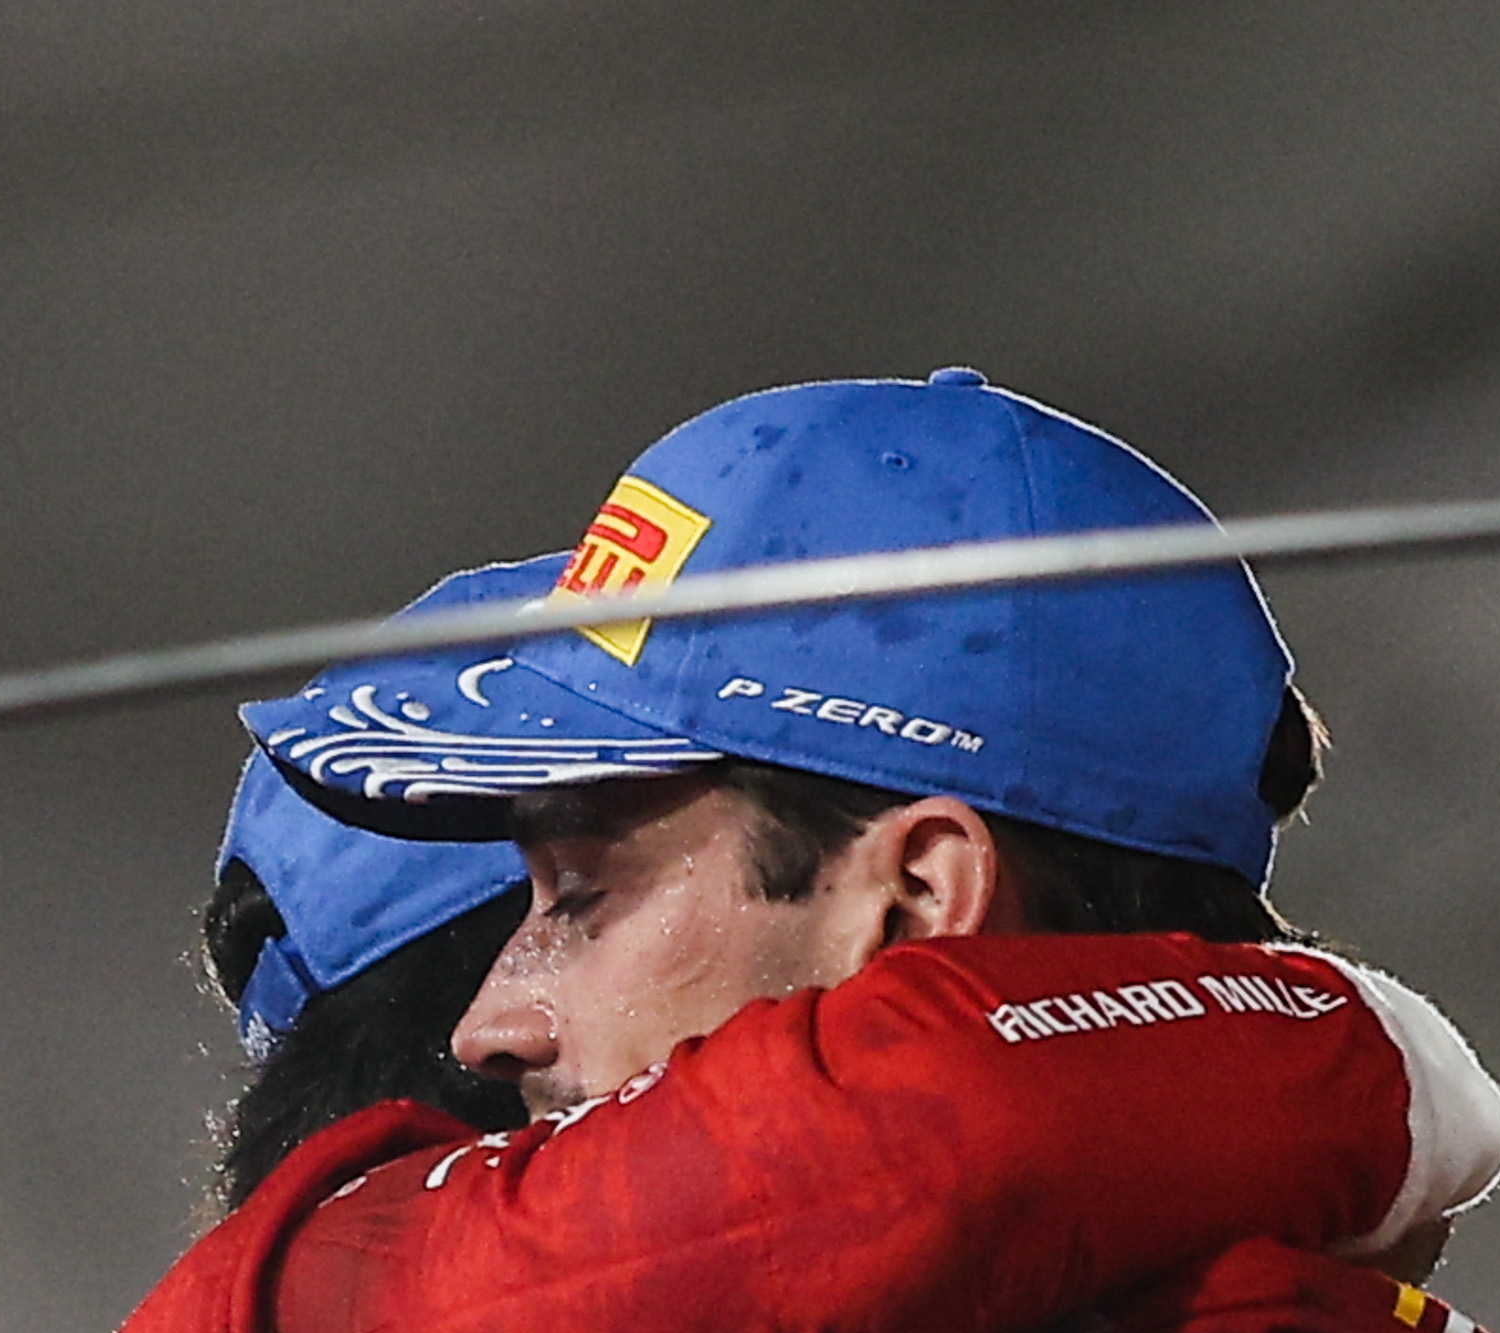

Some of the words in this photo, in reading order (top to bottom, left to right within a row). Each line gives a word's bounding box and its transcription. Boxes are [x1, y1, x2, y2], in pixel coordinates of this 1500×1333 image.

[718, 678, 764, 699] P
[985, 980, 1205, 1043] RICHARD
[1198, 975, 1347, 1019] MILLE
